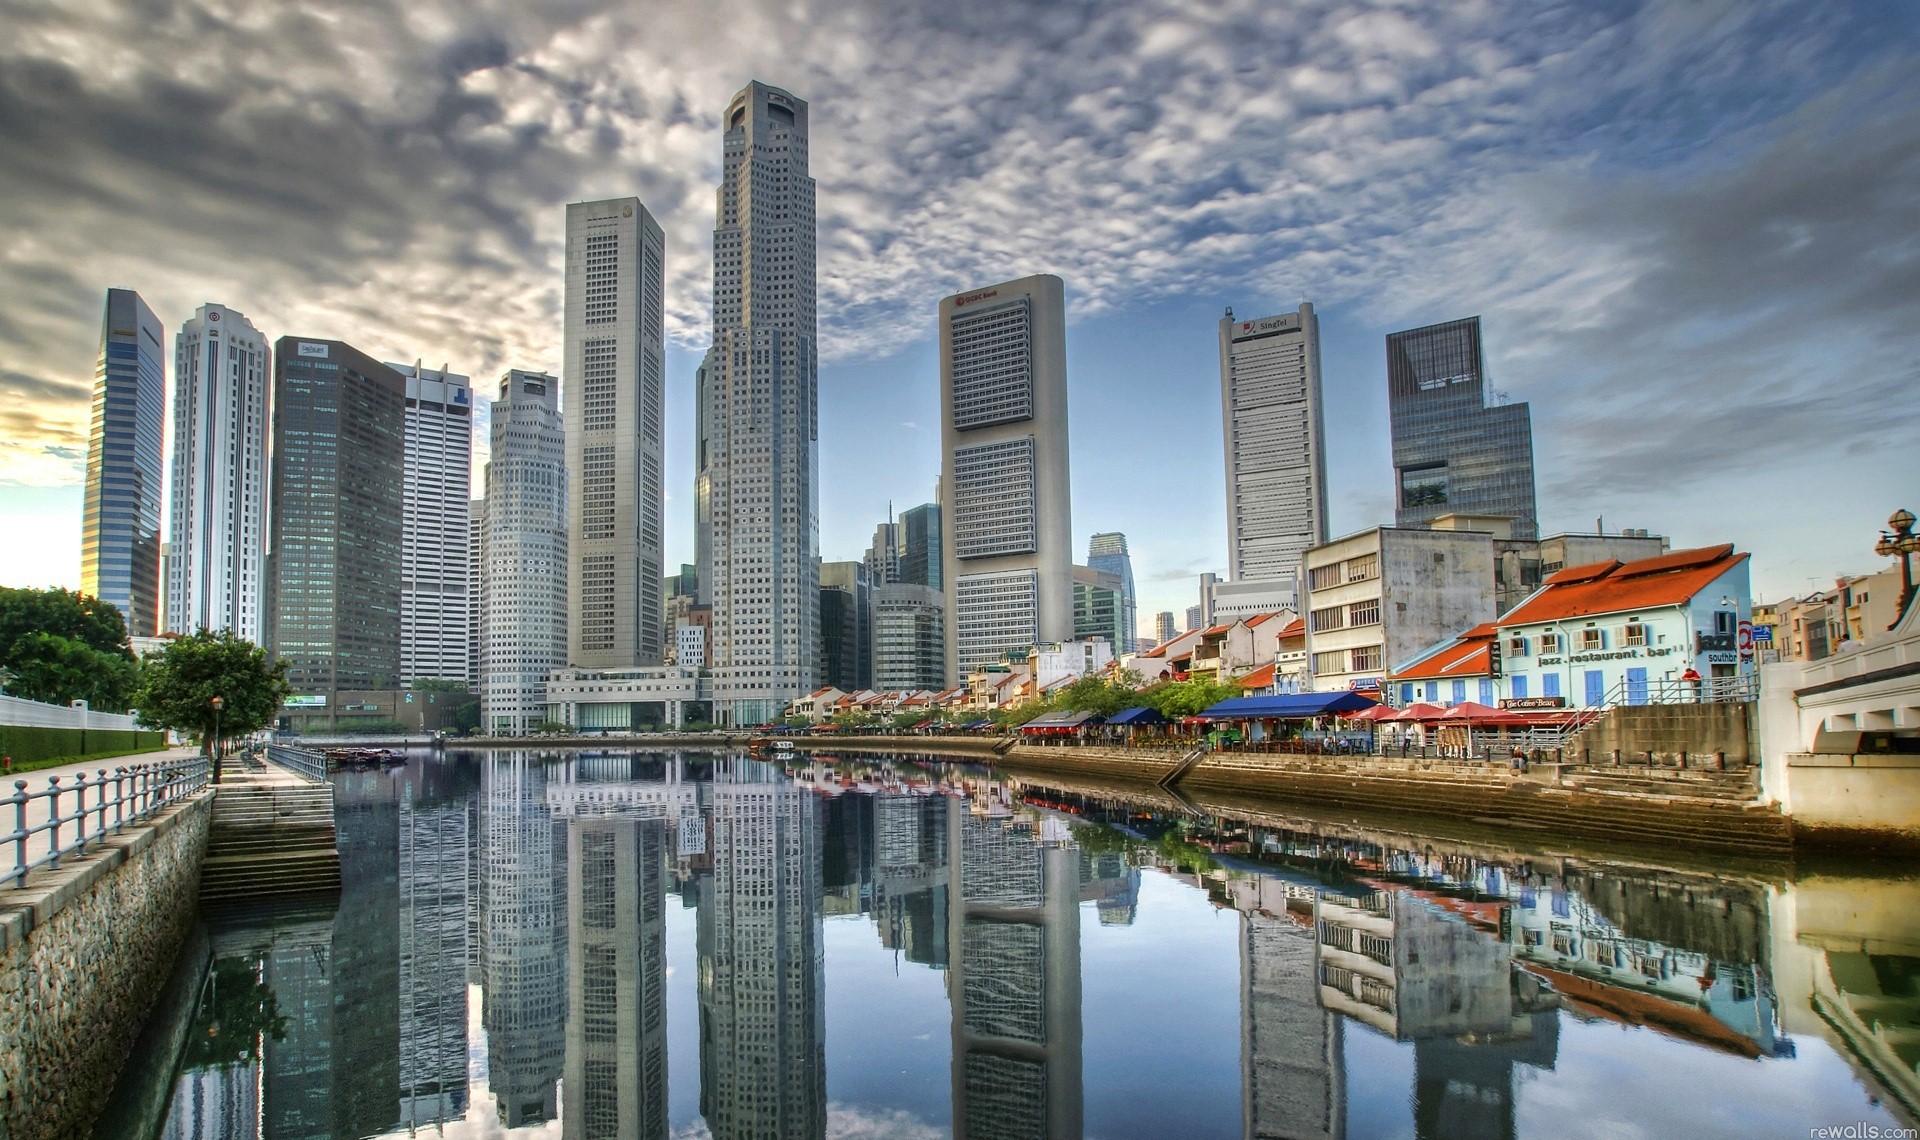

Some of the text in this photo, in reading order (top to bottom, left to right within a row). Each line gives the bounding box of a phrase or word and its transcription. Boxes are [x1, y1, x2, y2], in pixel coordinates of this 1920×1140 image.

[983, 290, 997, 298] Bank
[1260, 319, 1287, 330] SingTel
[1694, 630, 1738, 655] jazz
[1538, 647, 1672, 668] jazz restaurant bar
[1708, 652, 1754, 665] southbrge
[1506, 700, 1517, 709] The
[1536, 698, 1556, 708] Bean
